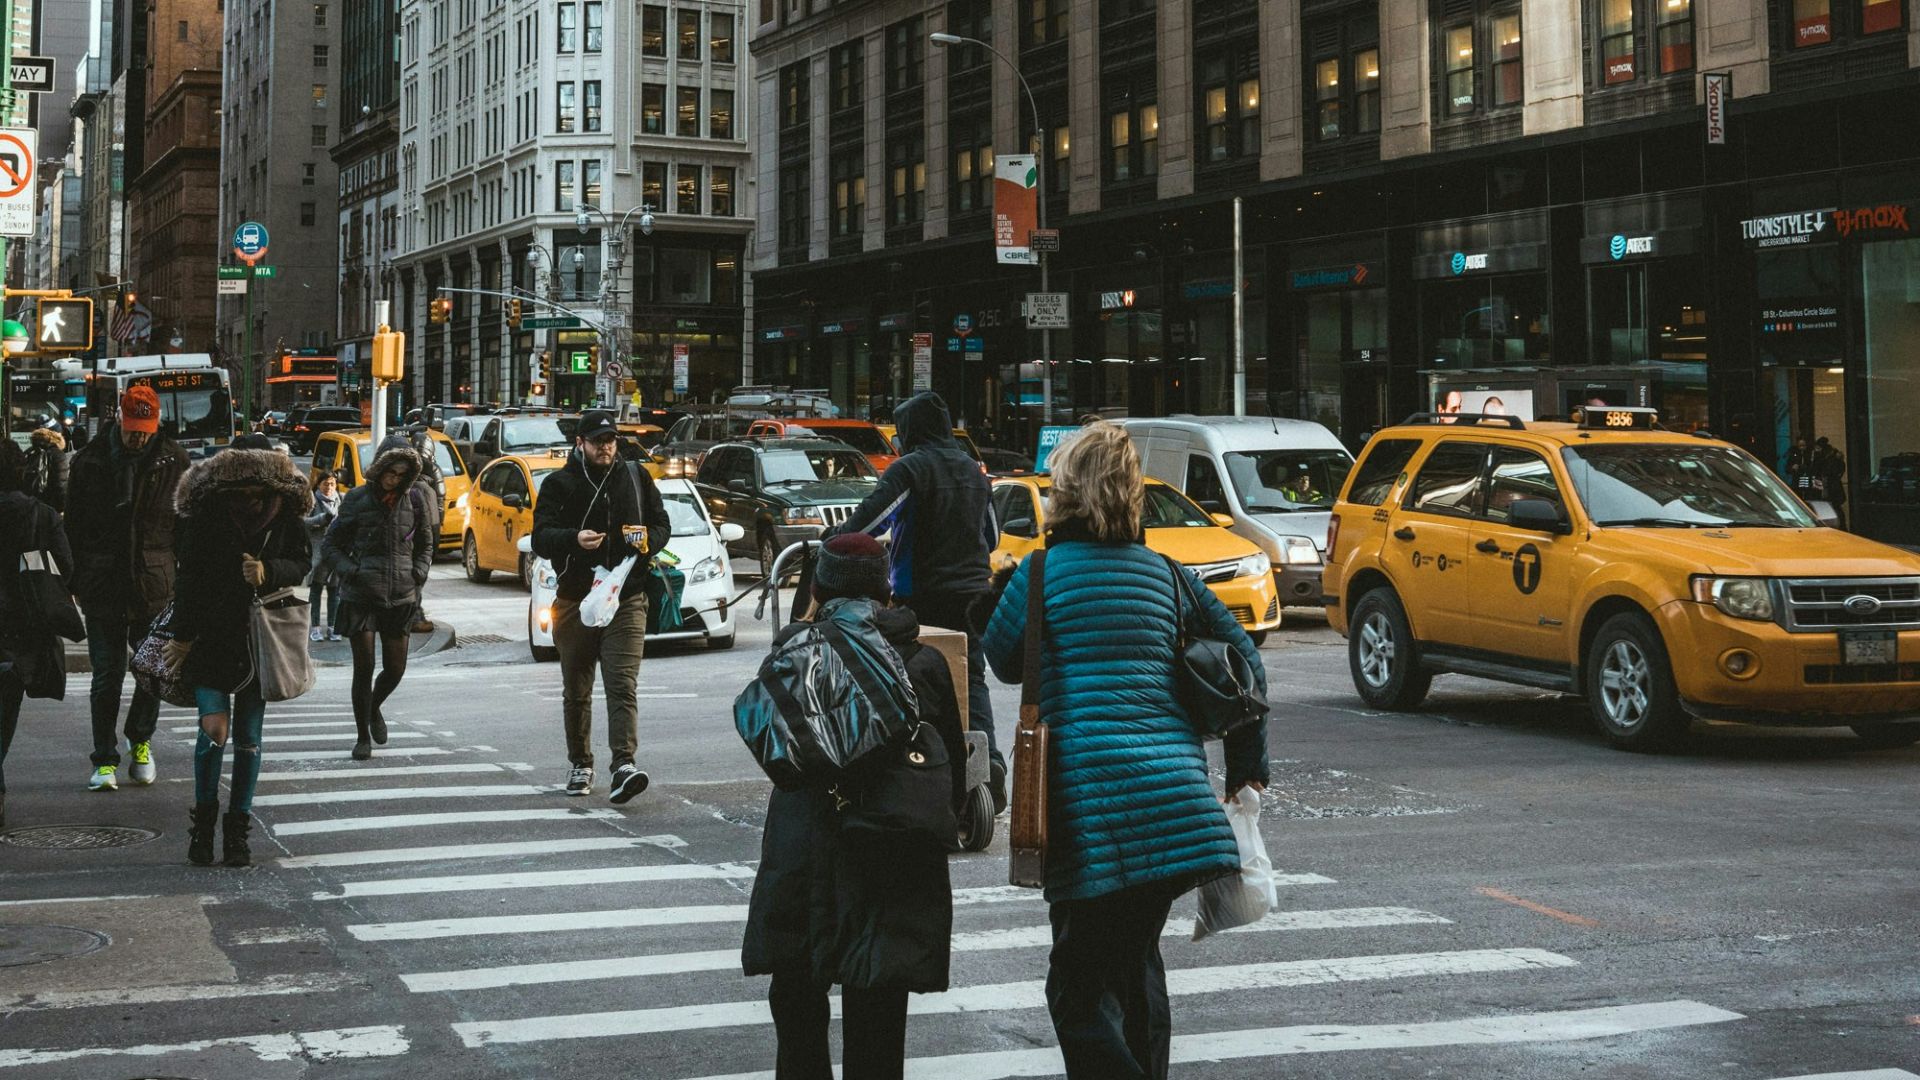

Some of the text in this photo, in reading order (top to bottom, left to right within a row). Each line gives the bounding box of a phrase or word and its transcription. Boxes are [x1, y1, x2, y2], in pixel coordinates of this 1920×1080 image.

[11, 67, 39, 80] WAY
[1740, 212, 1814, 240] TURNSTYLE
[1792, 234, 1810, 244] MARKET
[255, 267, 271, 276] MTA
[1037, 307, 1058, 315] ONLY
[1606, 412, 1632, 427] 5B56
[1041, 430, 1059, 445] BEST
